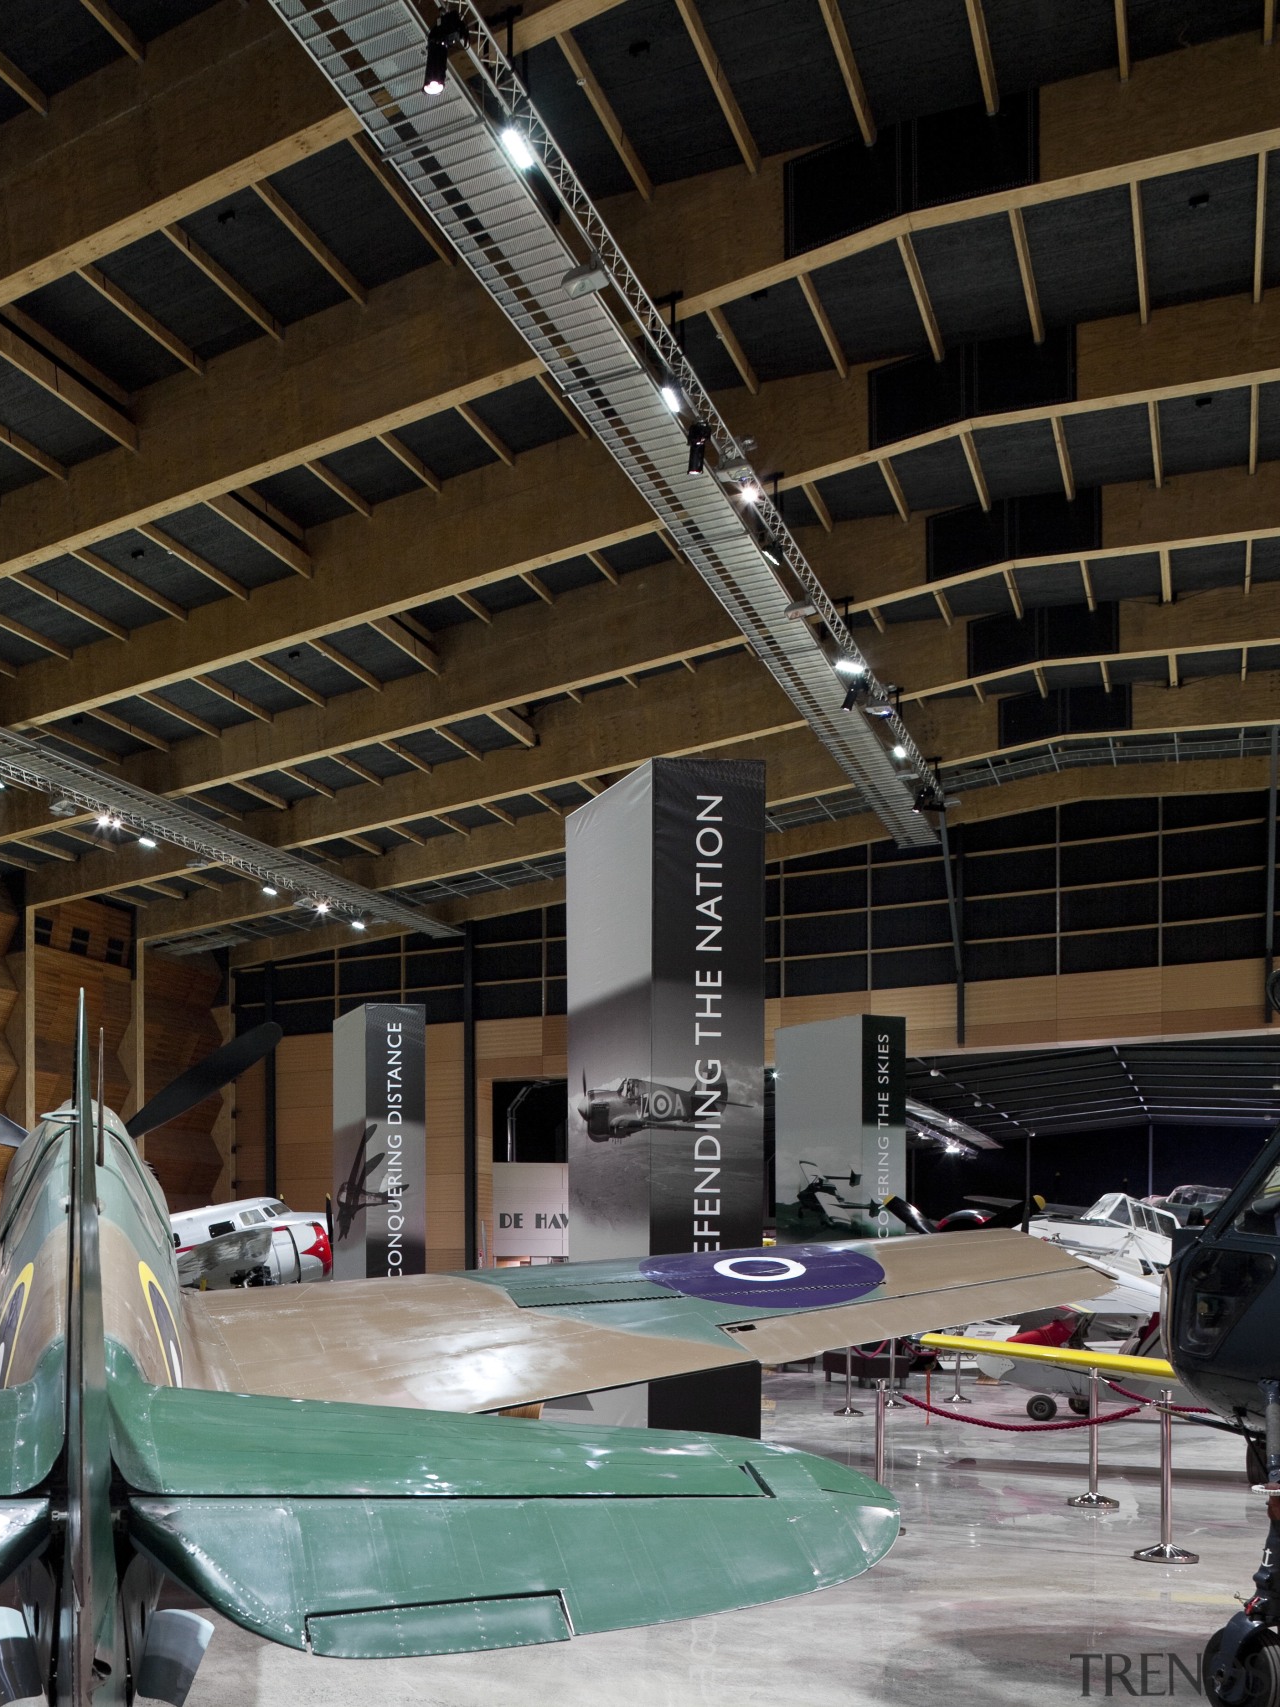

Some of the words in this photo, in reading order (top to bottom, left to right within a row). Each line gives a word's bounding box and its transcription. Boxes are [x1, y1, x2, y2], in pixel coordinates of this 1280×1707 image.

[695, 795, 723, 952] NATION
[695, 970, 722, 1045] THE
[387, 1022, 403, 1125] DISTANCE
[877, 1033, 889, 1084] SKIES
[693, 1058, 722, 1252] EFENDING
[877, 1092, 889, 1130] THE
[387, 1134, 405, 1278] CONQUERING
[499, 1213, 524, 1229] DE
